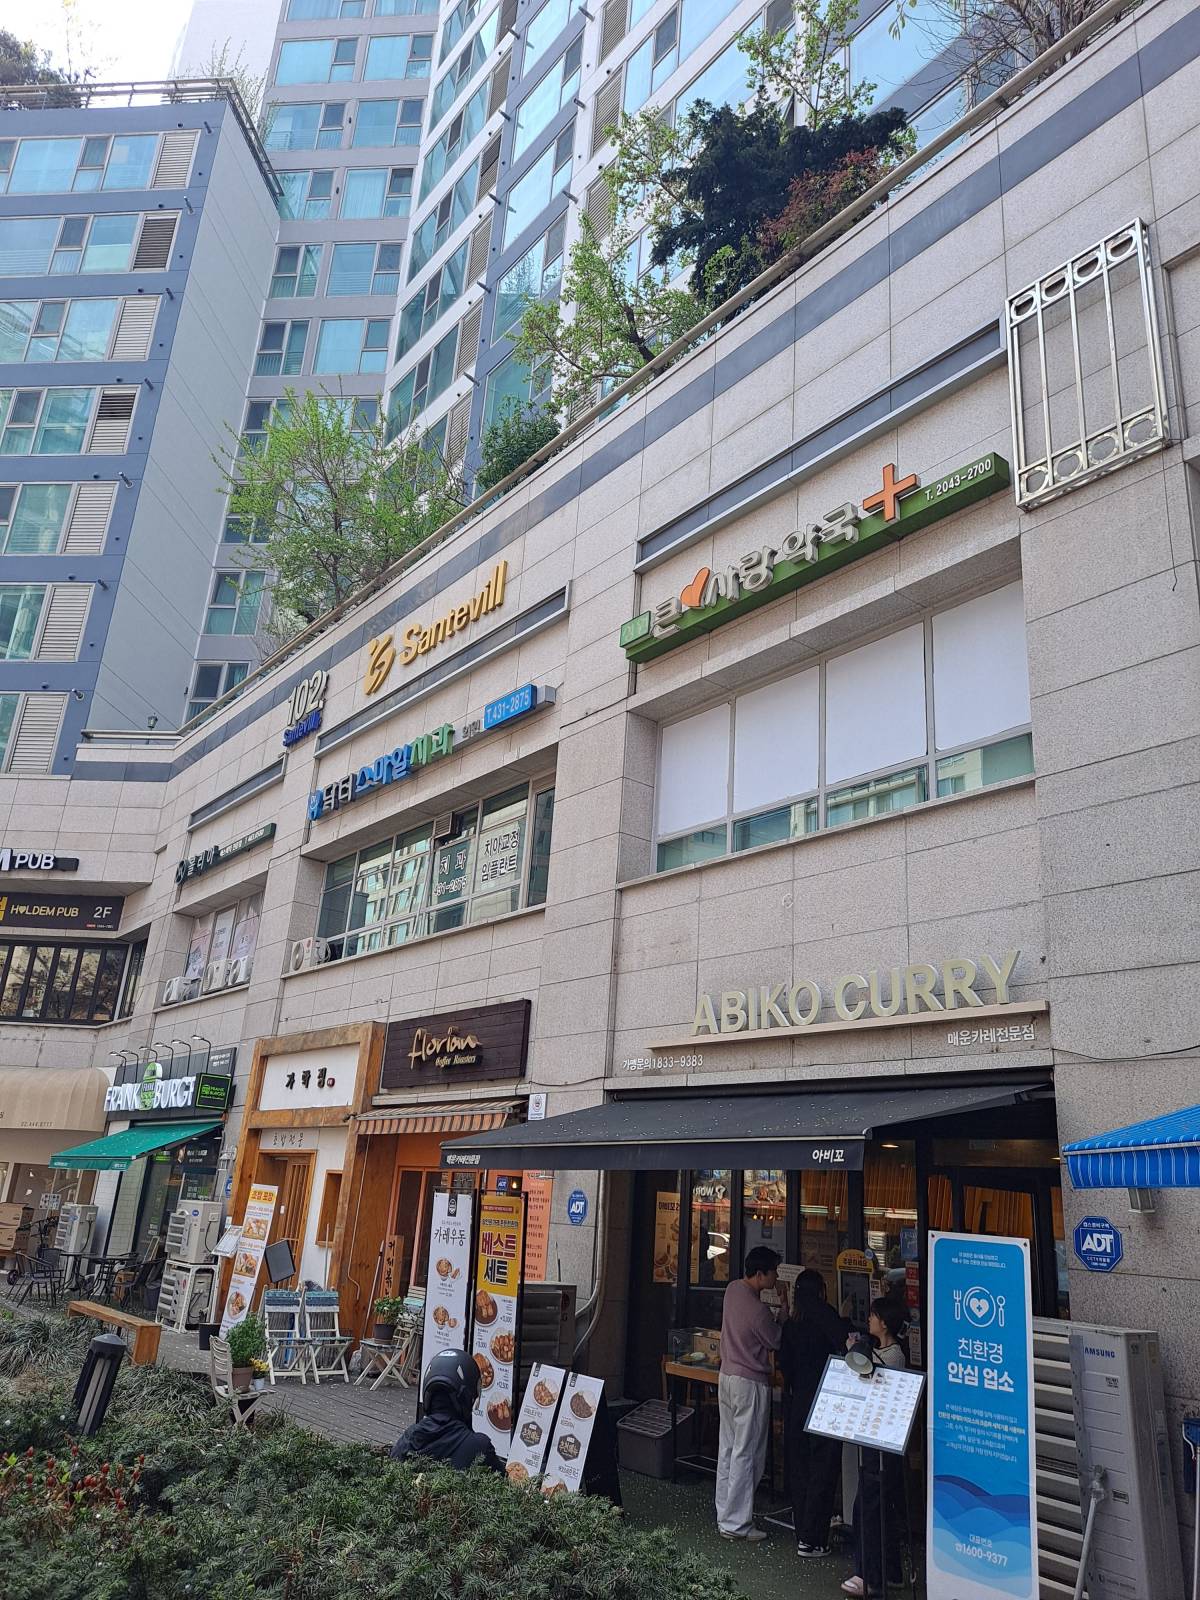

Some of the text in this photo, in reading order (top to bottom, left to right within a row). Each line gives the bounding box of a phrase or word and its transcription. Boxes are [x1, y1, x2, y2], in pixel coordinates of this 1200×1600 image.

[936, 458, 992, 497] 2043-2700
[399, 559, 508, 666] Santevill
[484, 827, 520, 858] 치아교정
[14, 853, 56, 870] PUB
[481, 854, 518, 883] 임플란트
[56, 907, 80, 917] PUB
[93, 906, 113, 919] 2F
[690, 949, 1022, 1037] ABIKO CURRY
[946, 1023, 1036, 1047] 매운카레전문점
[103, 1084, 142, 1112] FRANK
[811, 1148, 845, 1164] 아비꼬
[570, 1201, 585, 1214] ADT
[433, 1228, 467, 1248] 카레우동
[481, 1231, 517, 1257] 베스트
[1082, 1232, 1114, 1253] ADT
[484, 1259, 509, 1285] 세트
[957, 1336, 1004, 1365] 친환경
[1083, 1347, 1116, 1359] AMSUNG
[947, 1361, 1015, 1393] 안심 업소
